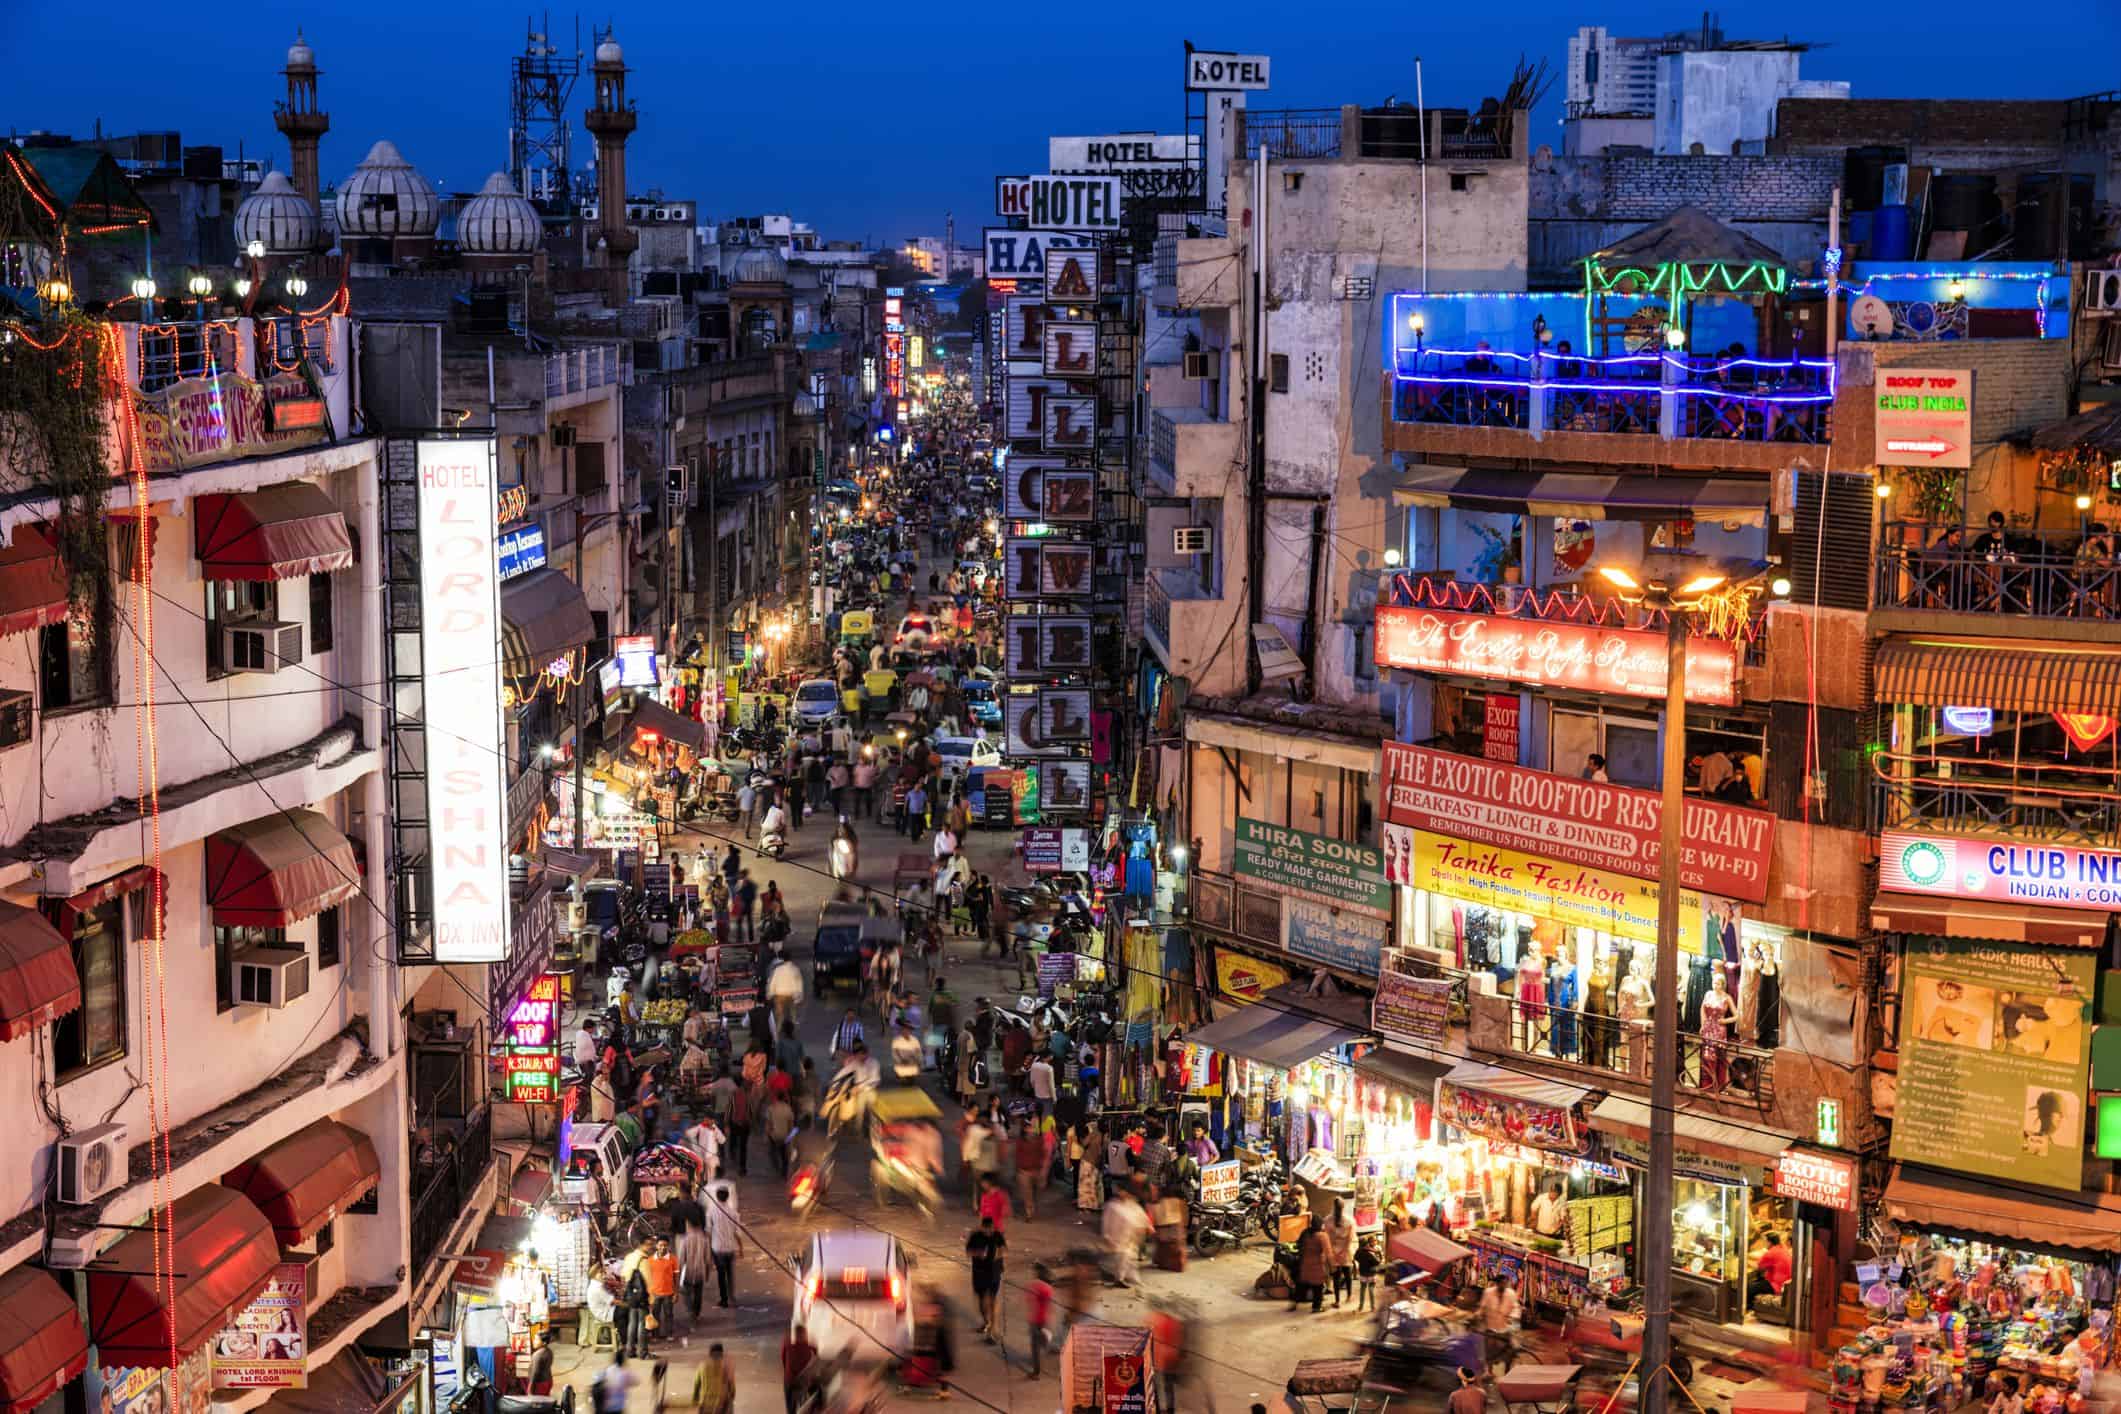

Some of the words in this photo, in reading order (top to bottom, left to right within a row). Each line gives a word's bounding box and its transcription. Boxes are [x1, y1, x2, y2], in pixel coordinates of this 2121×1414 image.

[1194, 60, 1266, 83] HOTEL
[1087, 142, 1160, 163] HOTEL
[1031, 180, 1118, 226] HOTEL
[1886, 377, 1925, 388] ROOF
[1927, 377, 1957, 389] TOP
[1879, 395, 1919, 410] CLUB
[1922, 395, 1967, 411] INDIA
[423, 465, 485, 488] HOTEL
[436, 499, 486, 633] LORD
[1387, 747, 1428, 785] THE
[1431, 756, 1506, 802] EXOTIC
[1508, 772, 1612, 822] ROOFTOP
[1249, 823, 1304, 850] HIRA
[1311, 838, 1378, 868] SONS
[1392, 788, 1483, 820] BREAKFAST
[1486, 807, 1542, 834] LUNCH
[1546, 822, 1559, 837] &
[1563, 824, 1632, 856] DINNER
[1700, 849, 1759, 882] WI-FI)
[1429, 817, 1495, 842] REMEMBER
[1496, 833, 1511, 844] US
[1513, 836, 1537, 851] FOR
[1539, 841, 1605, 866] DELICIOUS
[1606, 855, 1641, 873] FOOD
[1644, 862, 1705, 886] SECES
[1988, 845, 2067, 880] CLUB
[1247, 852, 1281, 871] READY
[1283, 862, 1313, 879] MADE
[1316, 870, 1377, 895] GARMENTS
[1436, 842, 1515, 880] Tanika
[1526, 861, 1626, 906] Fashion
[1262, 869, 1306, 888] COMPLETE
[1311, 881, 1342, 897] FAMILY
[1343, 890, 1369, 903] SHOP
[1468, 875, 1488, 890] High
[1490, 880, 1522, 897] Fashion
[2009, 881, 2070, 900] INDIAN
[2086, 888, 2121, 904] CON
[1969, 945, 2008, 964] VEDIC
[517, 1024, 545, 1044] TOP
[513, 1072, 549, 1086] FREE
[517, 1087, 548, 1100] WI-FI
[1779, 1158, 1849, 1187] EXOTIC
[1777, 1183, 1848, 1209] RESTAURANT
[1783, 1174, 1841, 1195] ROOFTOP
[216, 1368, 242, 1376] HOTEL
[244, 1368, 265, 1376] LORD
[267, 1368, 303, 1376] KRISHNA
